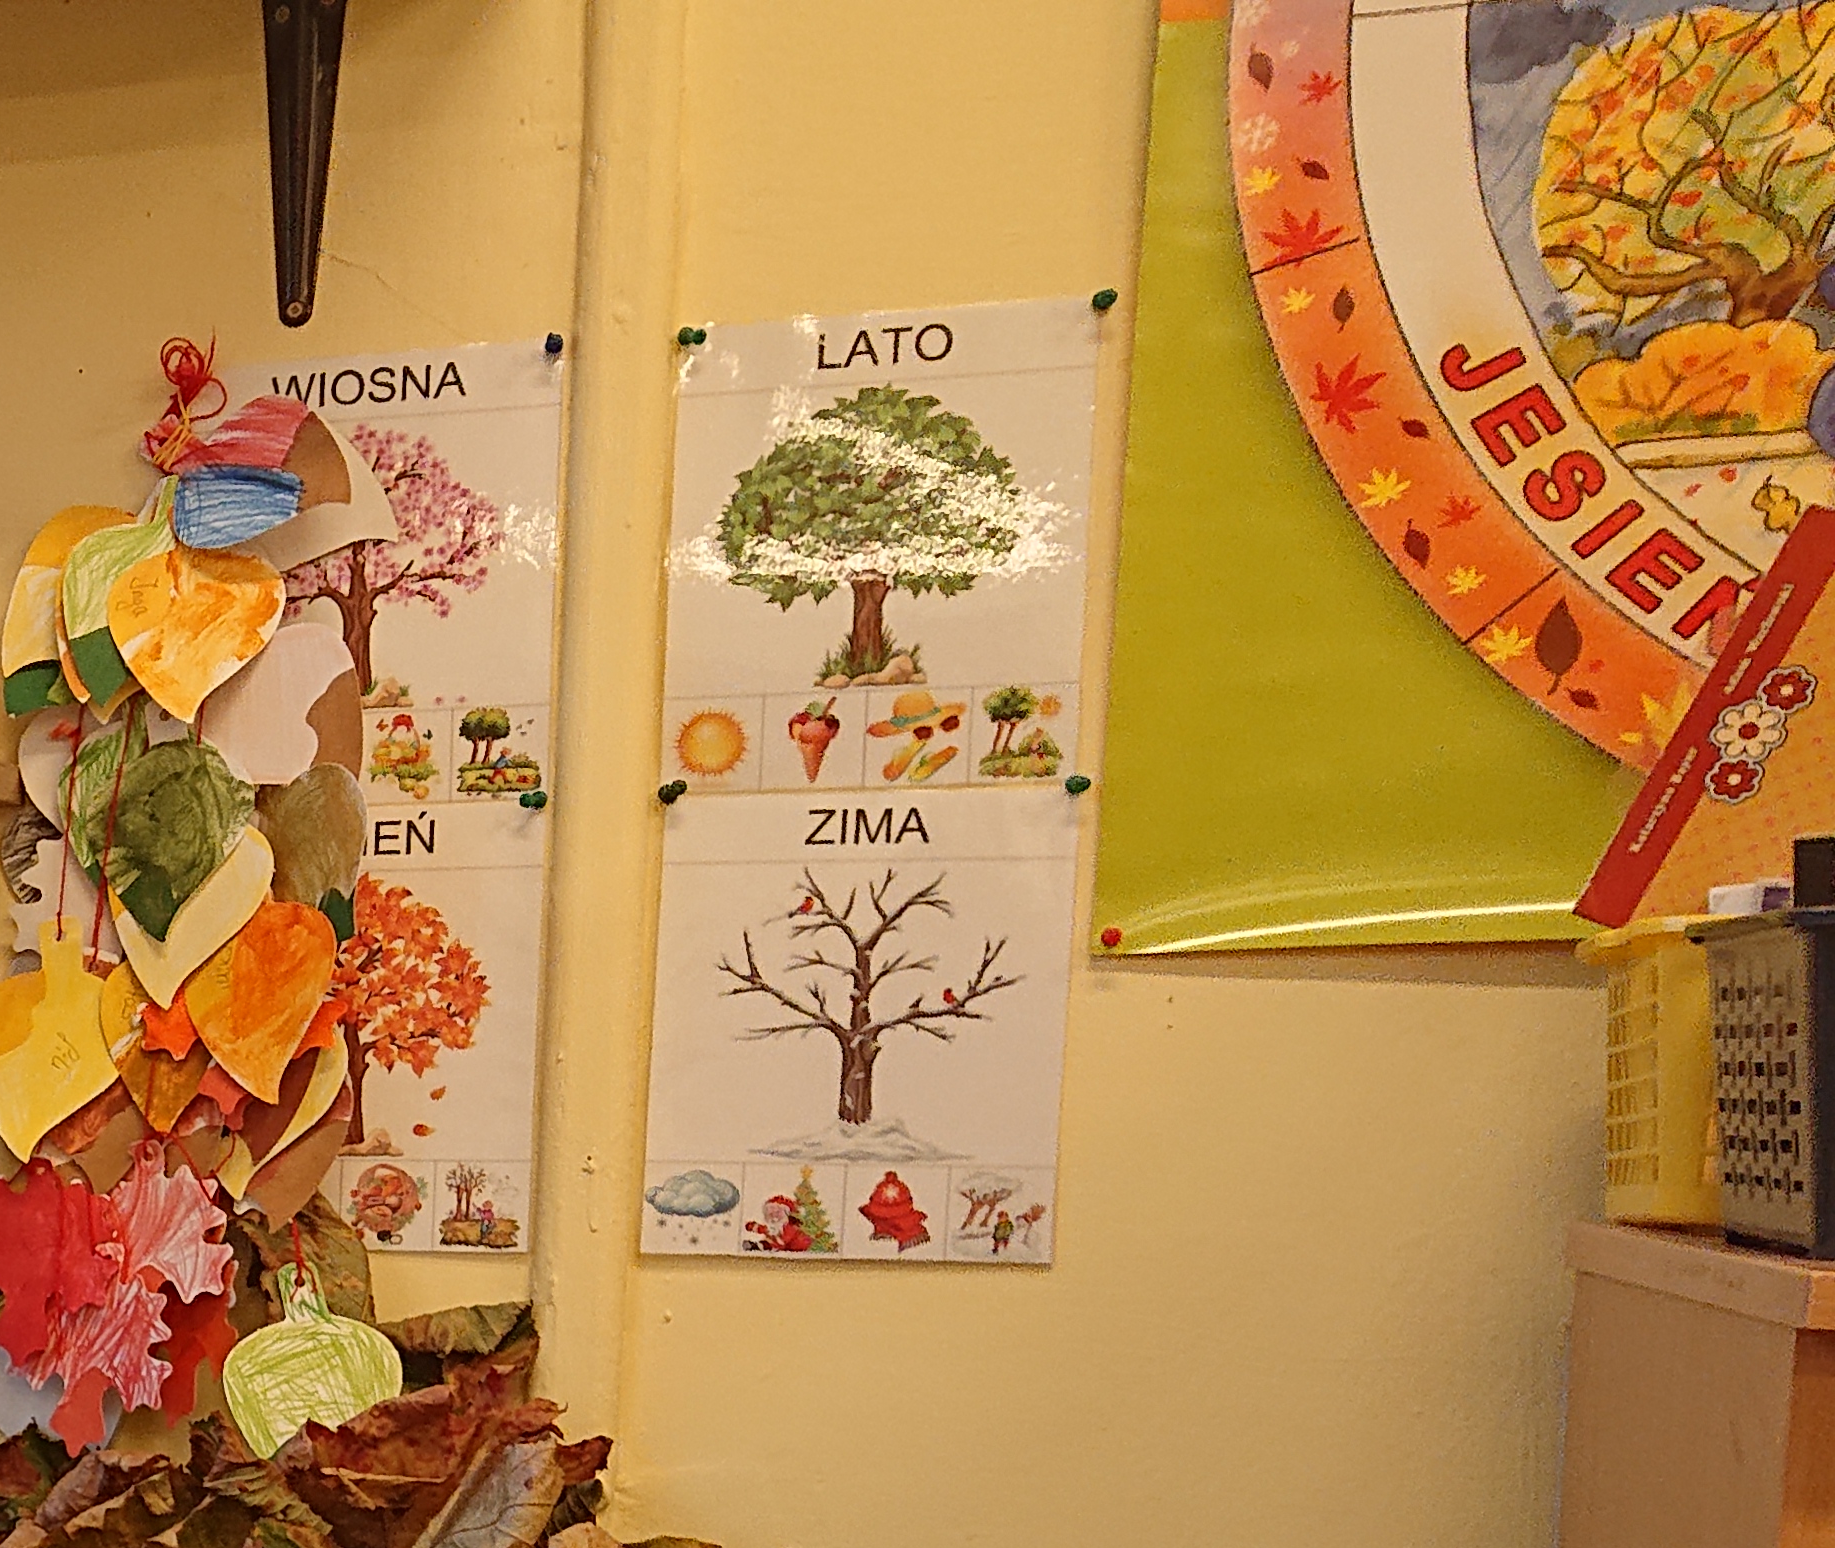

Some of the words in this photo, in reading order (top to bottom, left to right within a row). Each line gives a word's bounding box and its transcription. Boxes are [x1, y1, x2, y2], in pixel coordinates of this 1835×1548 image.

[817, 323, 953, 369] LATO
[272, 361, 467, 407] WIOSNA
[804, 806, 930, 845] ZIMA
